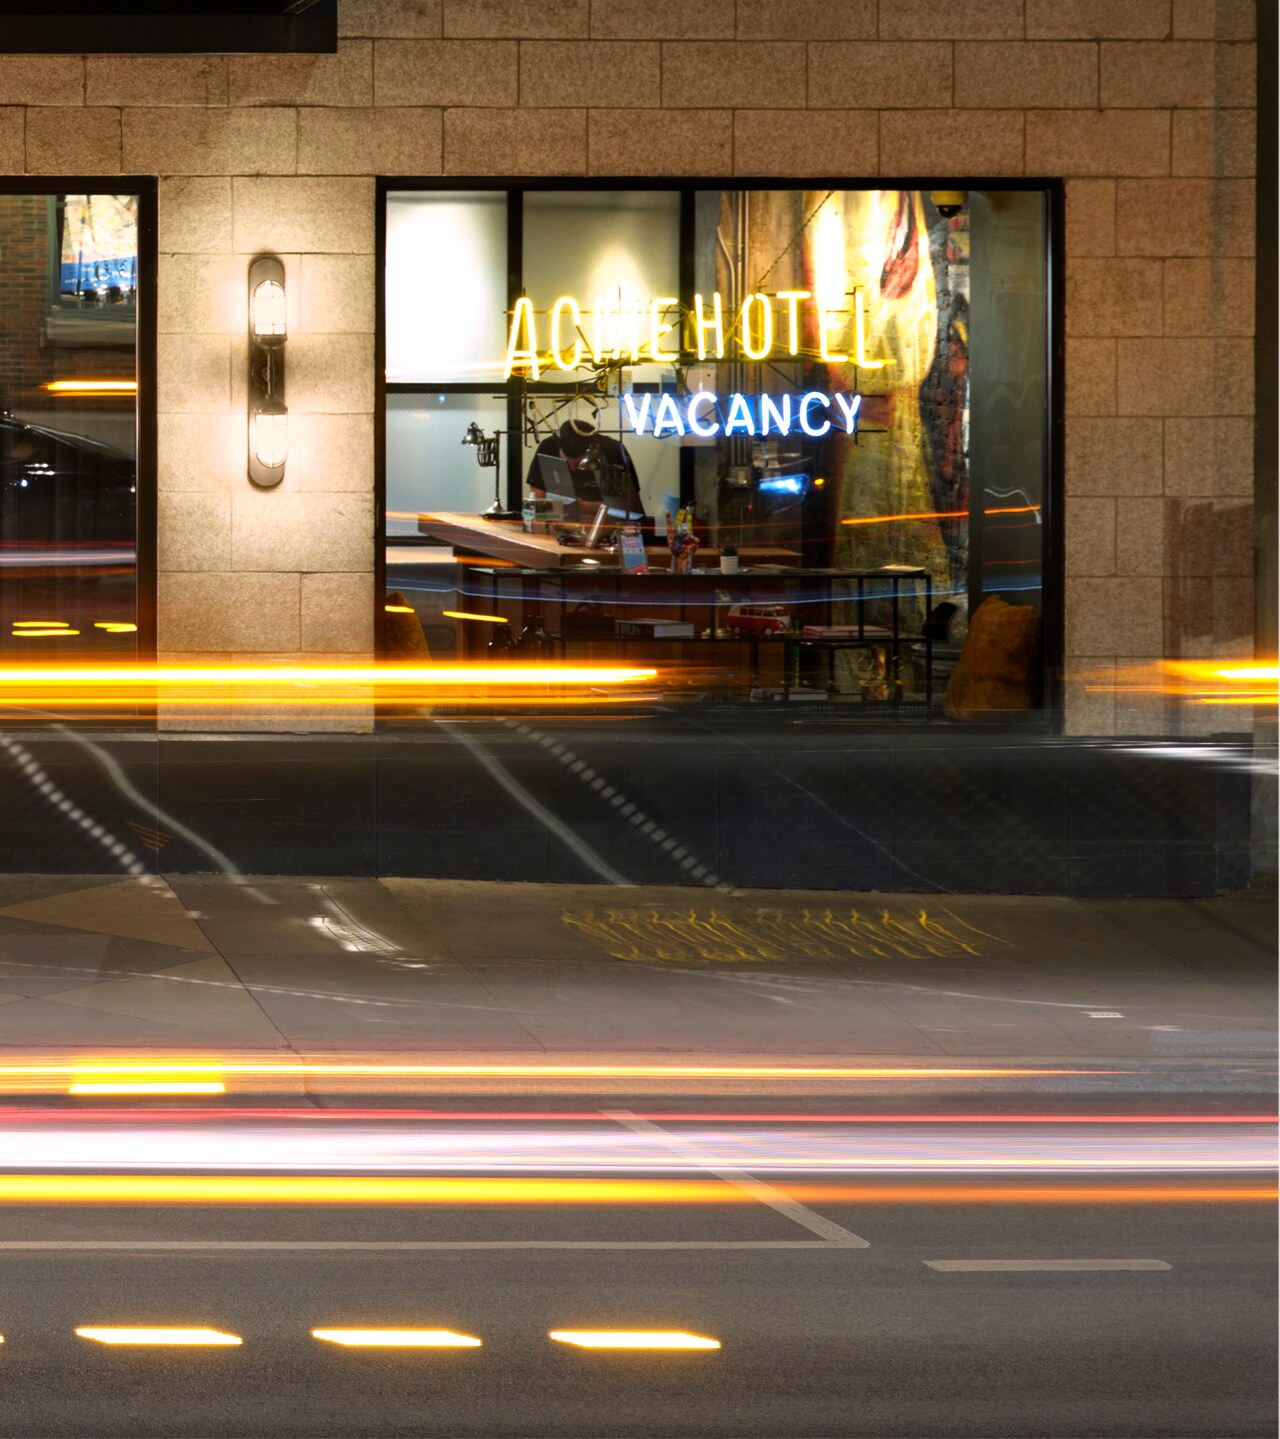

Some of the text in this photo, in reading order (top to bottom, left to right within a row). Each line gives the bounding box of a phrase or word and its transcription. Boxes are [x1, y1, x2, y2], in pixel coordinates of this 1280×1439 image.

[503, 291, 885, 381] ACME HOTEL
[624, 391, 862, 437] VACANCY
